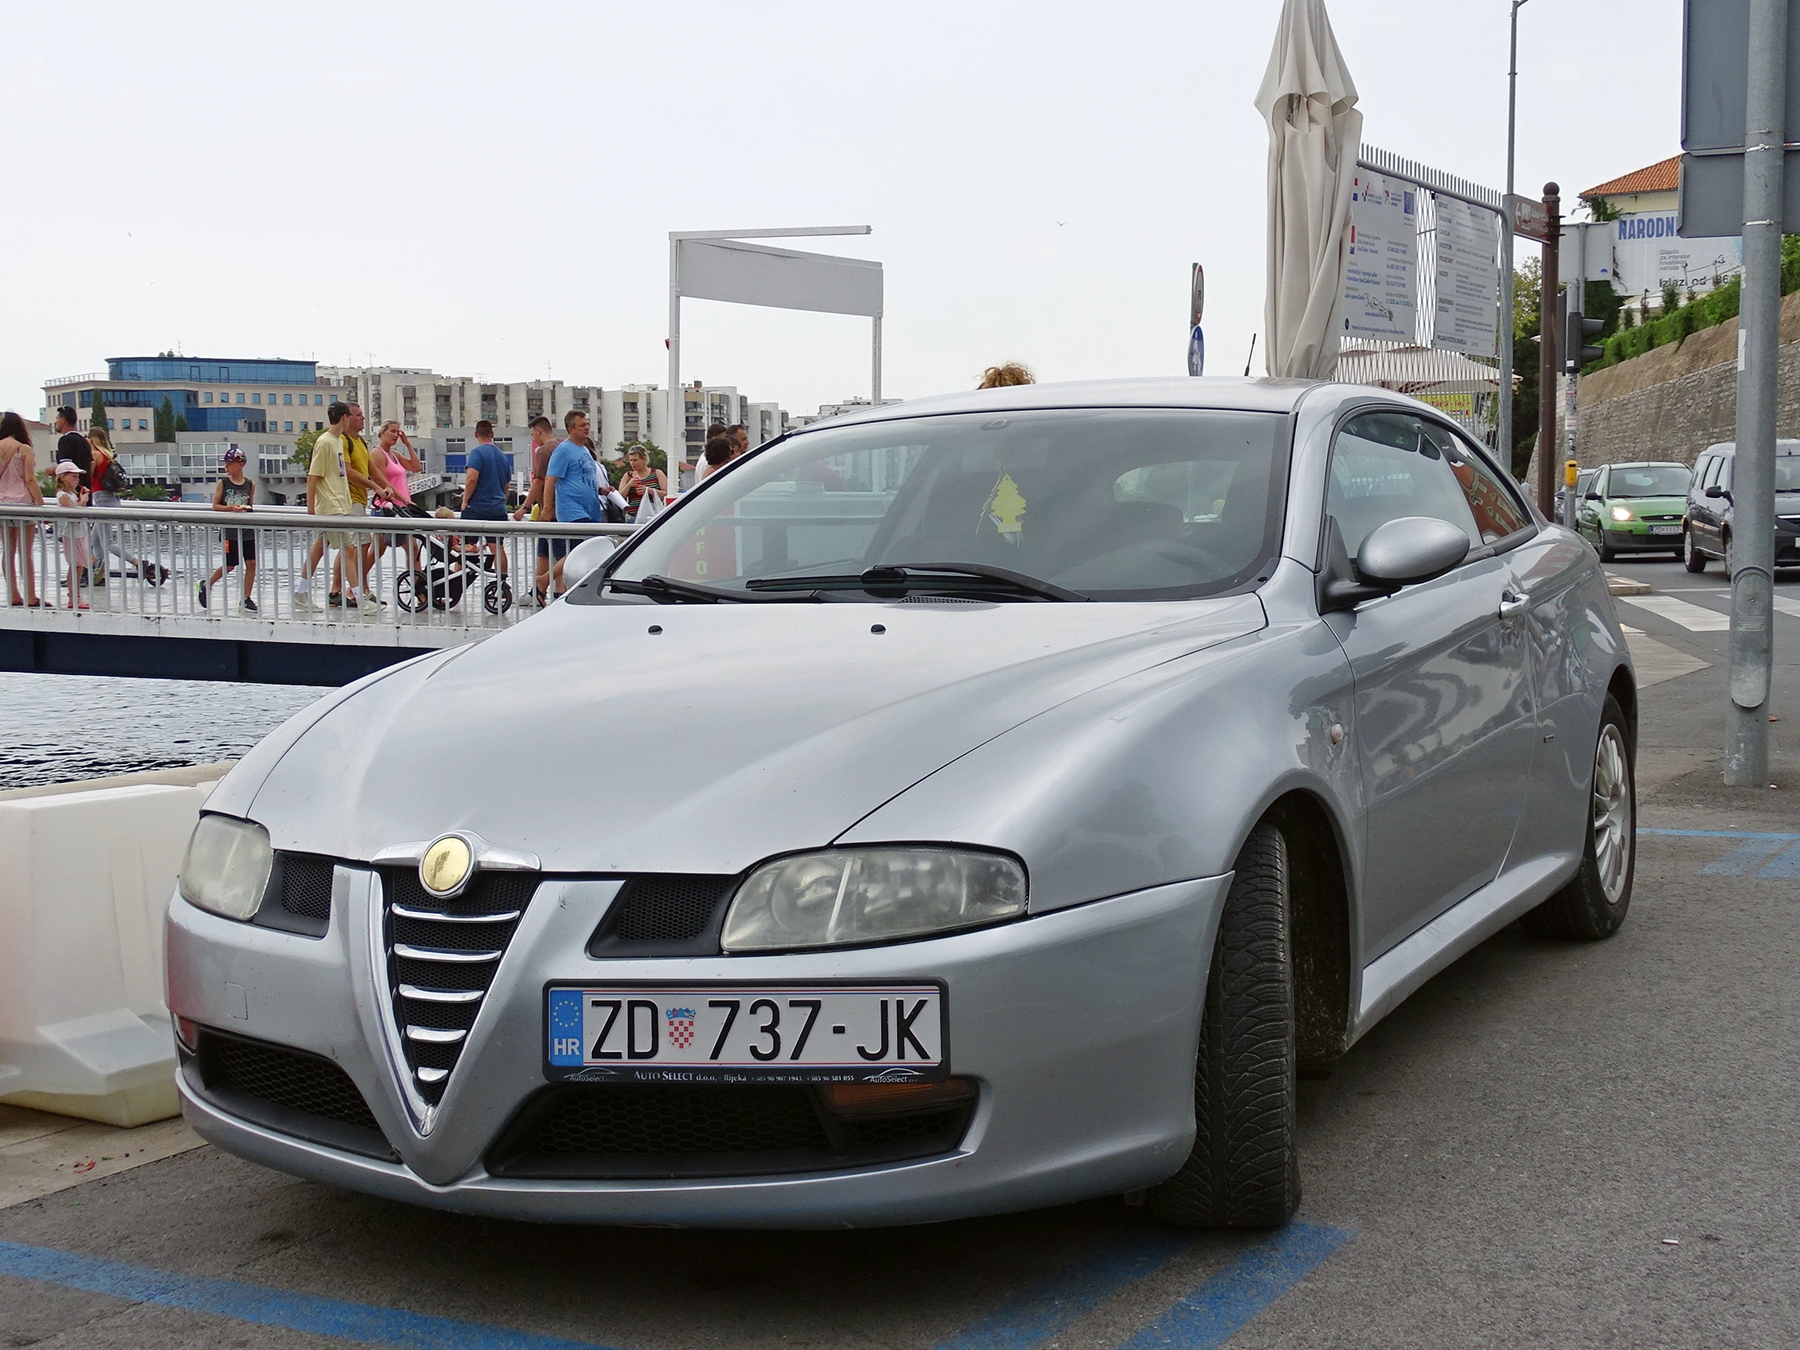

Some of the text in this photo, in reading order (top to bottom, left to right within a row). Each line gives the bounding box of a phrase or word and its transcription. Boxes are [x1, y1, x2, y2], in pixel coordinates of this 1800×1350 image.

[1691, 276, 1707, 286] od
[590, 999, 660, 1060] ZD
[554, 1038, 581, 1056] HR
[633, 1071, 661, 1081] AUTO
[662, 1071, 694, 1081] SELECT
[723, 1074, 747, 1083] Rijeka
[870, 1075, 907, 1083] AutoSelect
